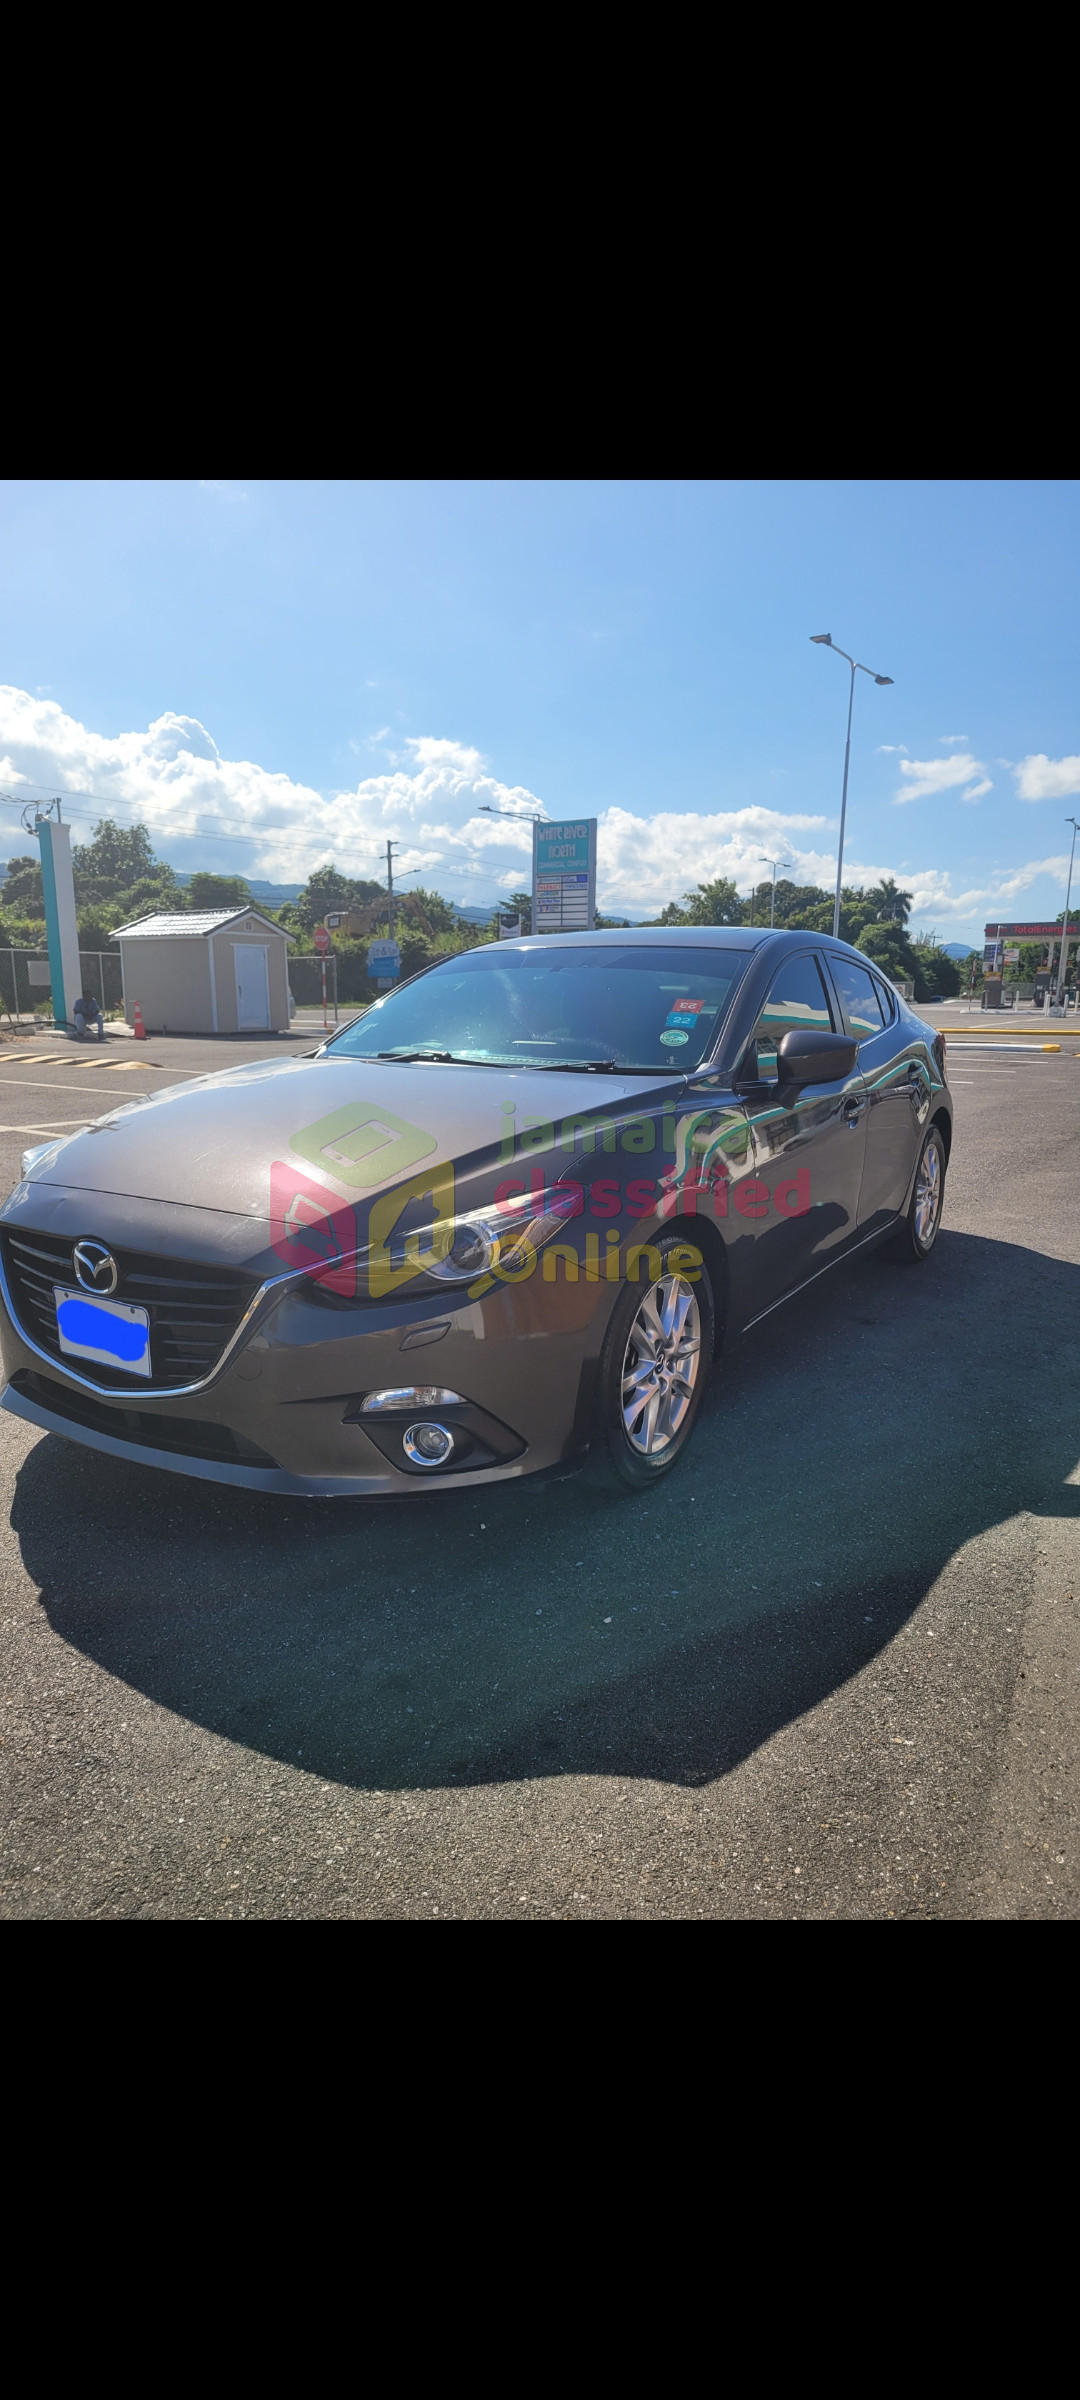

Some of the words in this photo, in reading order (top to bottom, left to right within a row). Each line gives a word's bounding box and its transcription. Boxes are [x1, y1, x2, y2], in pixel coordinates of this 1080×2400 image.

[539, 827, 562, 841] WHITE
[564, 825, 587, 838] RIVER
[549, 844, 575, 858] NORTH
[1013, 925, 1077, 935] TotalEnerges
[673, 1016, 691, 1024] 22
